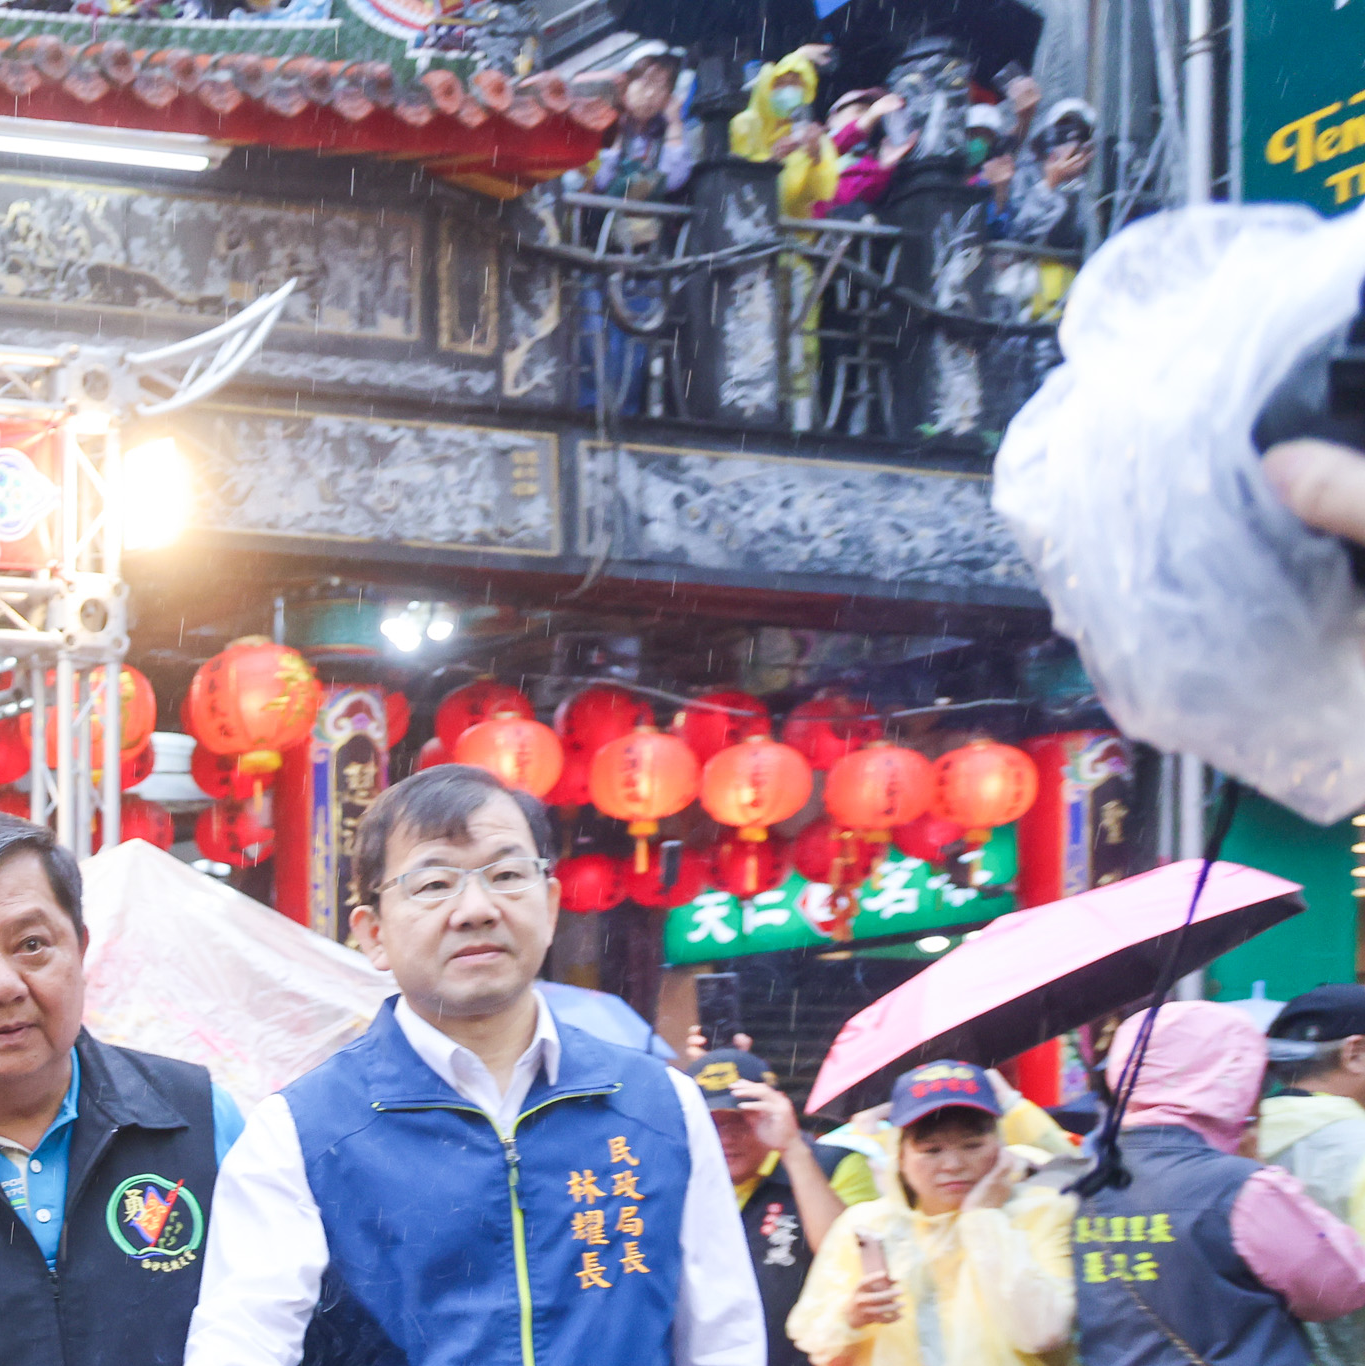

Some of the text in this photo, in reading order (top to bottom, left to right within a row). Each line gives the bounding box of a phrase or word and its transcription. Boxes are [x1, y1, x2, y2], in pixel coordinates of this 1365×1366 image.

[566, 1169, 613, 1289] 林耀長
[607, 1135, 651, 1274] 民政局長
